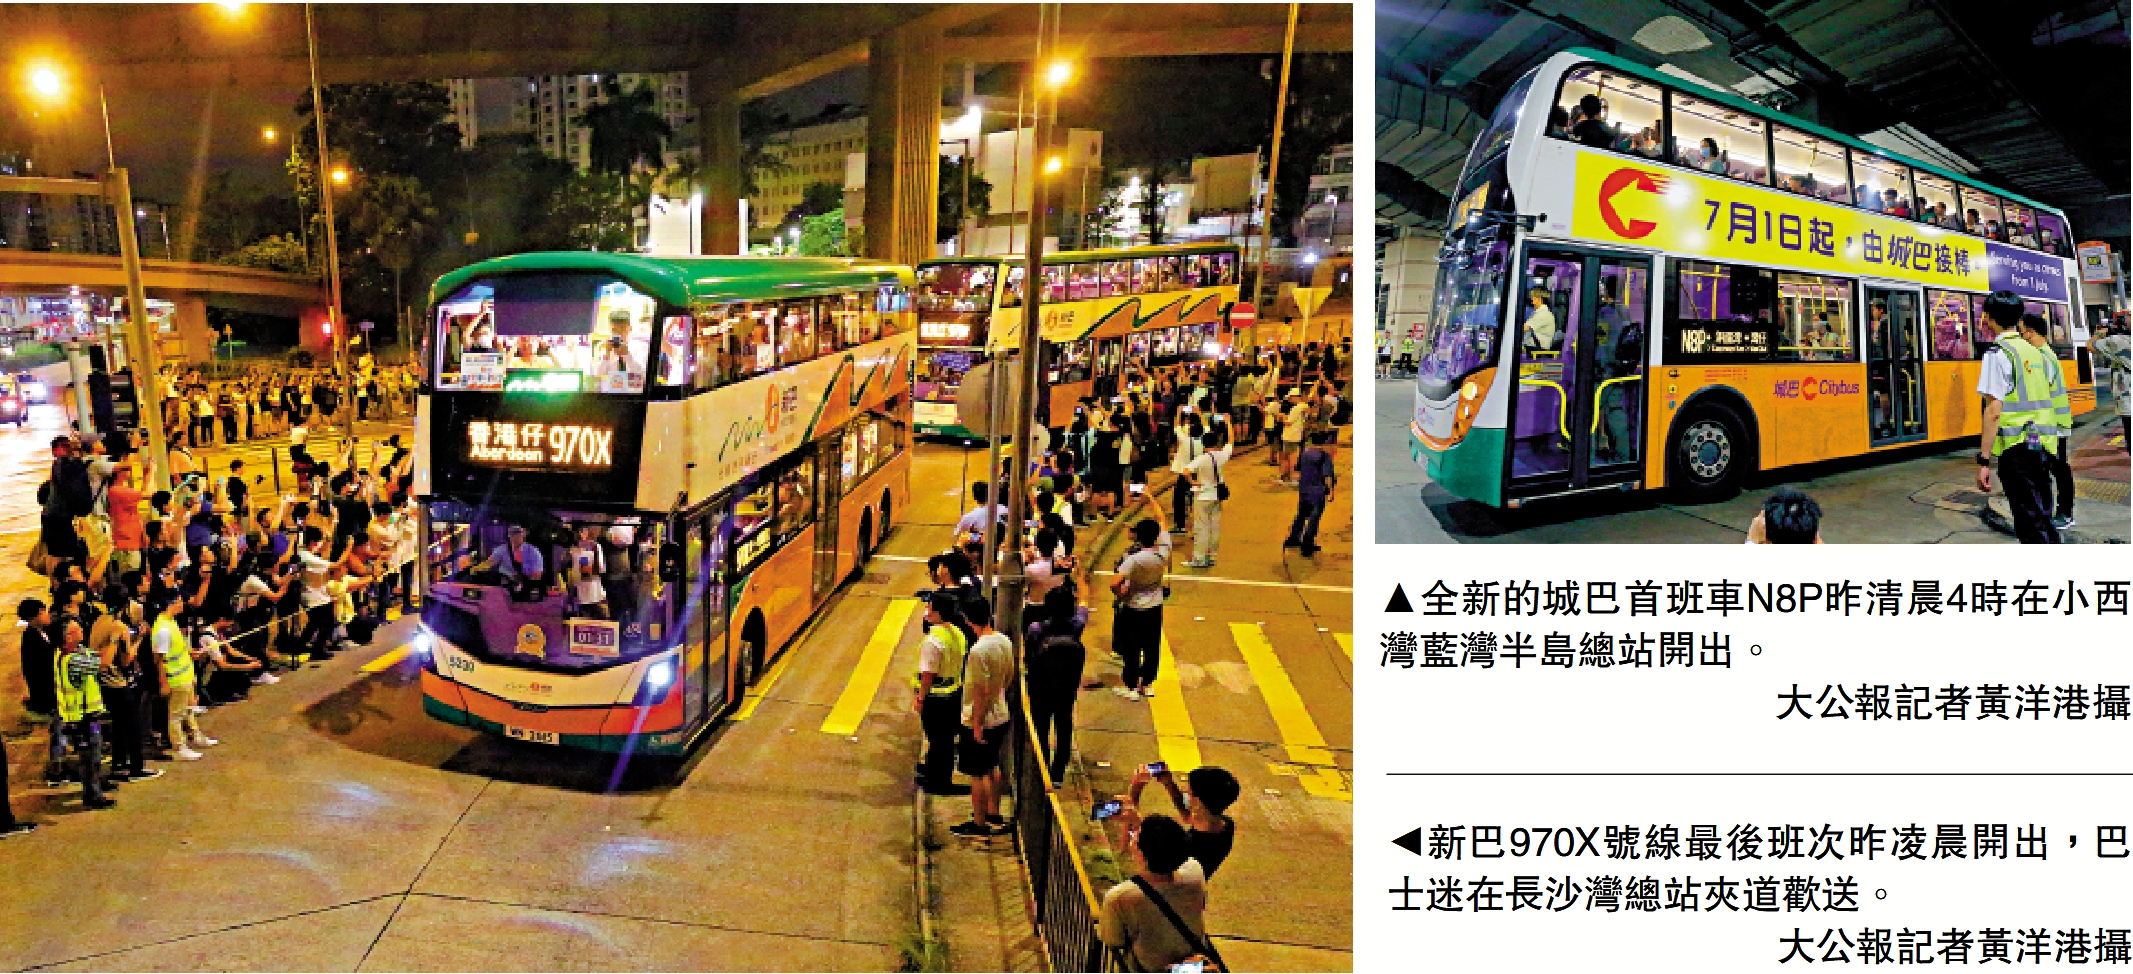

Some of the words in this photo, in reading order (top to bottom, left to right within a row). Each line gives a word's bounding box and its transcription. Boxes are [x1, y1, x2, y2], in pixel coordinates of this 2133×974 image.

[1681, 329, 1706, 353] N8P
[1774, 379, 1800, 398] 城巴
[1819, 379, 1860, 397] Citybus
[468, 420, 546, 448] 香港仔
[549, 425, 613, 465] 970X
